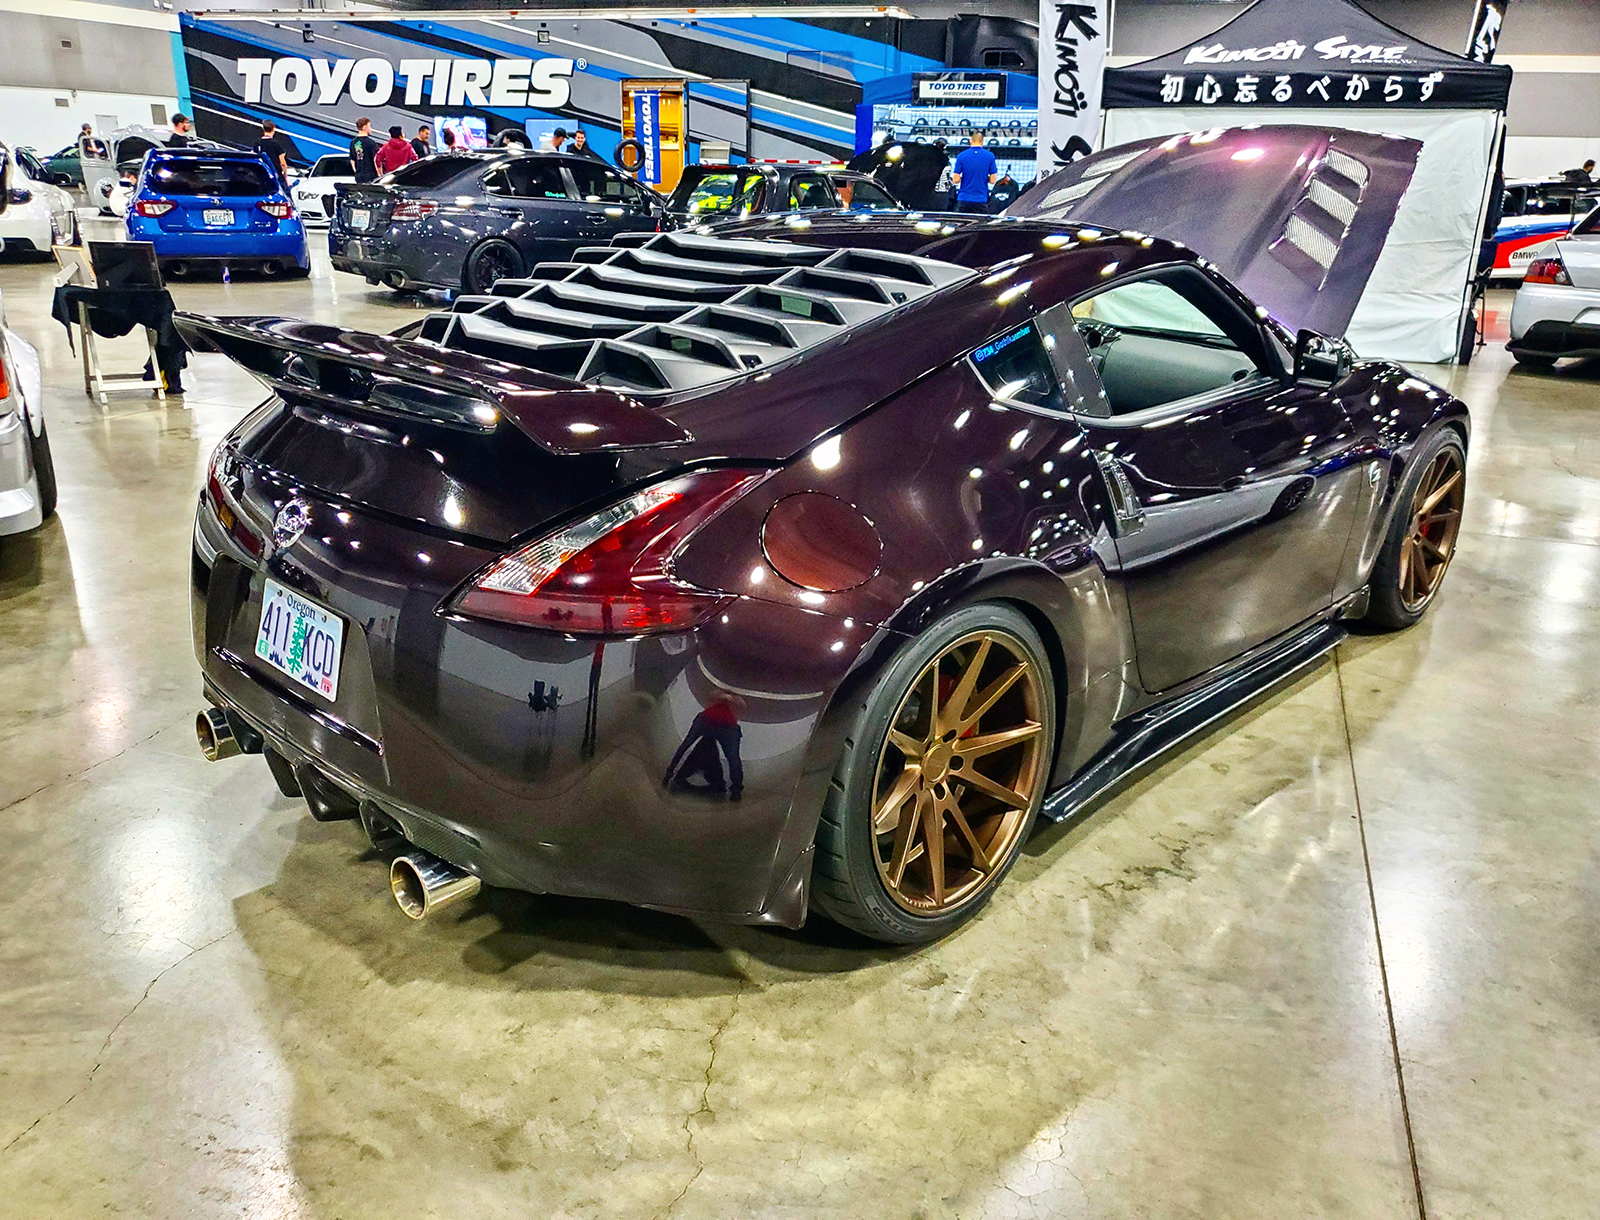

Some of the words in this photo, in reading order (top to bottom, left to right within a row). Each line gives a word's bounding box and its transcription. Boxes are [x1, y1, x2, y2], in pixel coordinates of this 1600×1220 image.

[1314, 35, 1408, 60] STYLE
[237, 57, 394, 106] TOYO
[399, 57, 574, 108] TIRES
[1160, 71, 1445, 104] 初心忘るべからず
[642, 95, 653, 136] TOYO
[643, 136, 654, 180] TIRES
[286, 594, 316, 619] Oregon
[261, 601, 292, 652] 411
[301, 622, 335, 678] KCD
